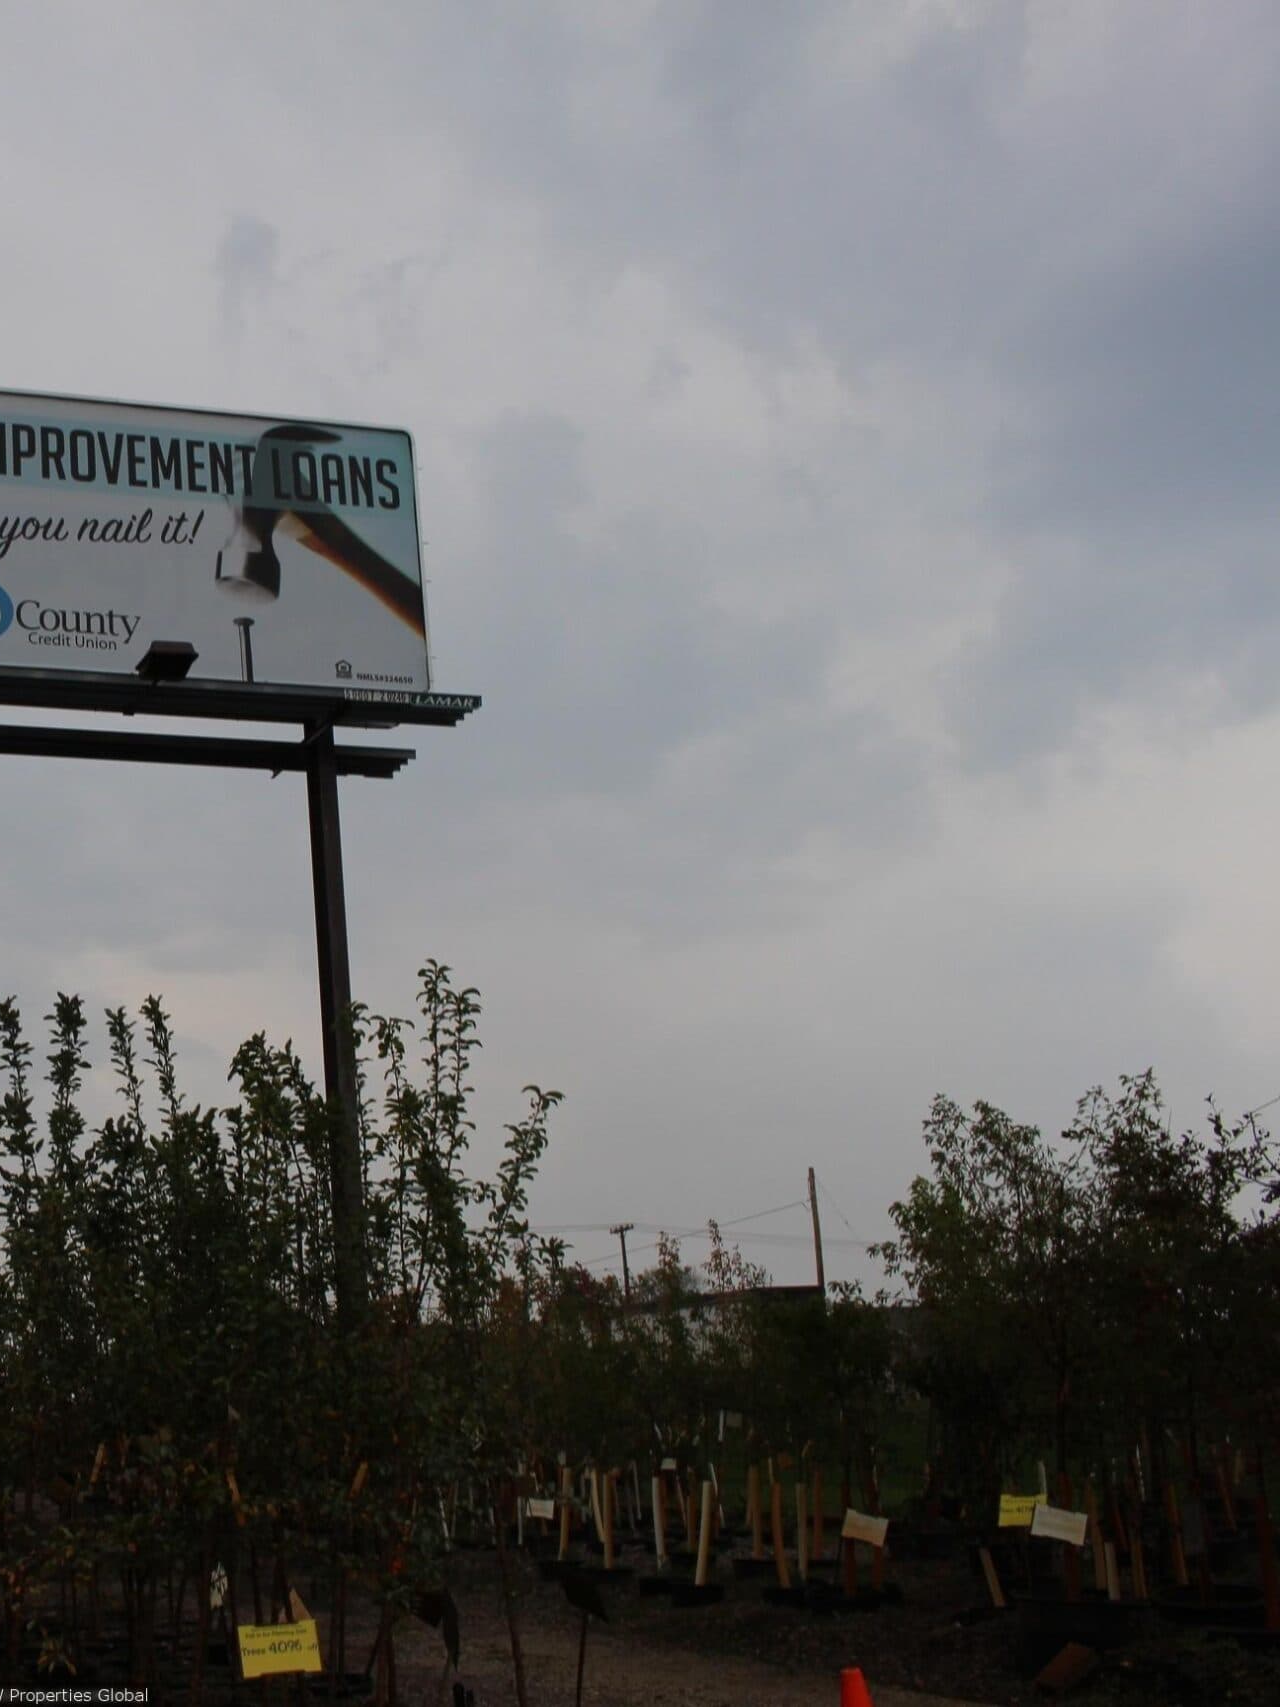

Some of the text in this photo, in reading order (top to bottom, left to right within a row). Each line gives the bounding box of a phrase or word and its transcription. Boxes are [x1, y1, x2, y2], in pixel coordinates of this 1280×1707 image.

[272, 448, 401, 510] LOANS
[77, 507, 153, 545] nail
[160, 509, 205, 545] it!
[16, 599, 141, 645] County
[28, 632, 117, 651] Credit Union
[414, 696, 475, 707] LAMAR
[269, 1640, 302, 1654] 40%
